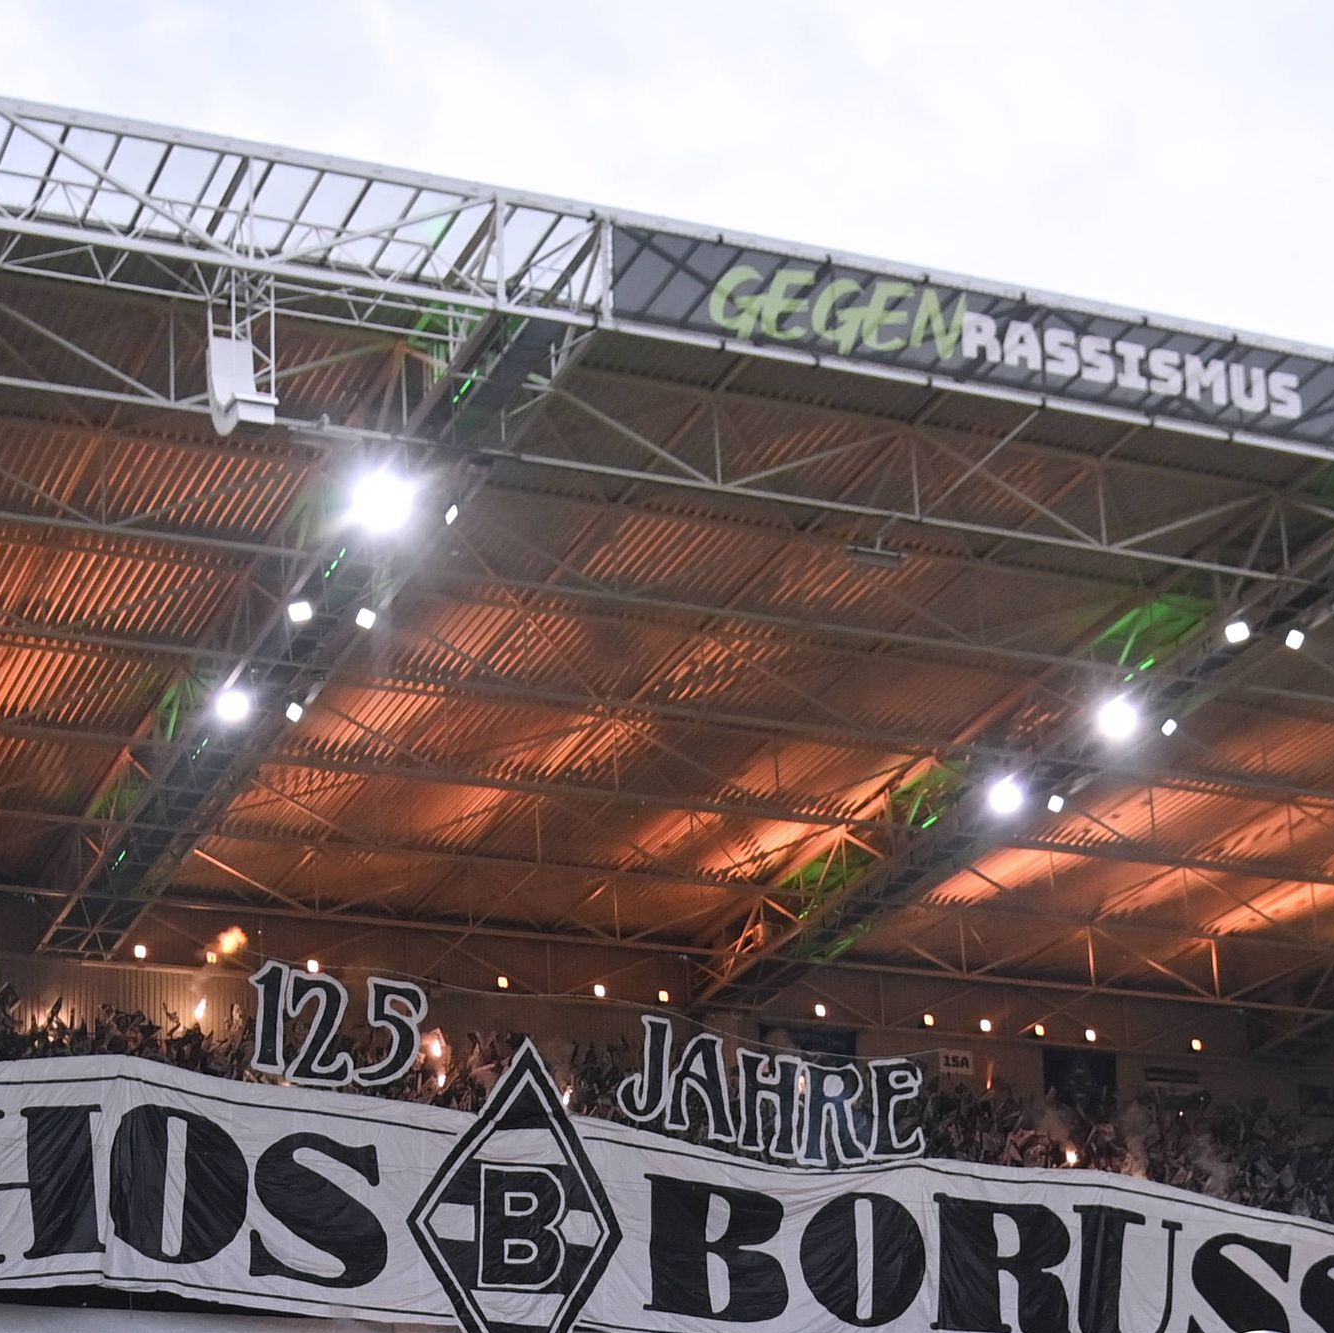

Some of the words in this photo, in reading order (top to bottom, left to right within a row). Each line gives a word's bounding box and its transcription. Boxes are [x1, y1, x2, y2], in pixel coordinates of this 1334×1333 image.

[708, 264, 967, 362] GEGEN
[961, 309, 1304, 419] RASSISMUS
[249, 959, 428, 1087] 125
[616, 1014, 926, 1167] JAHRE
[943, 1055, 970, 1070] 15A
